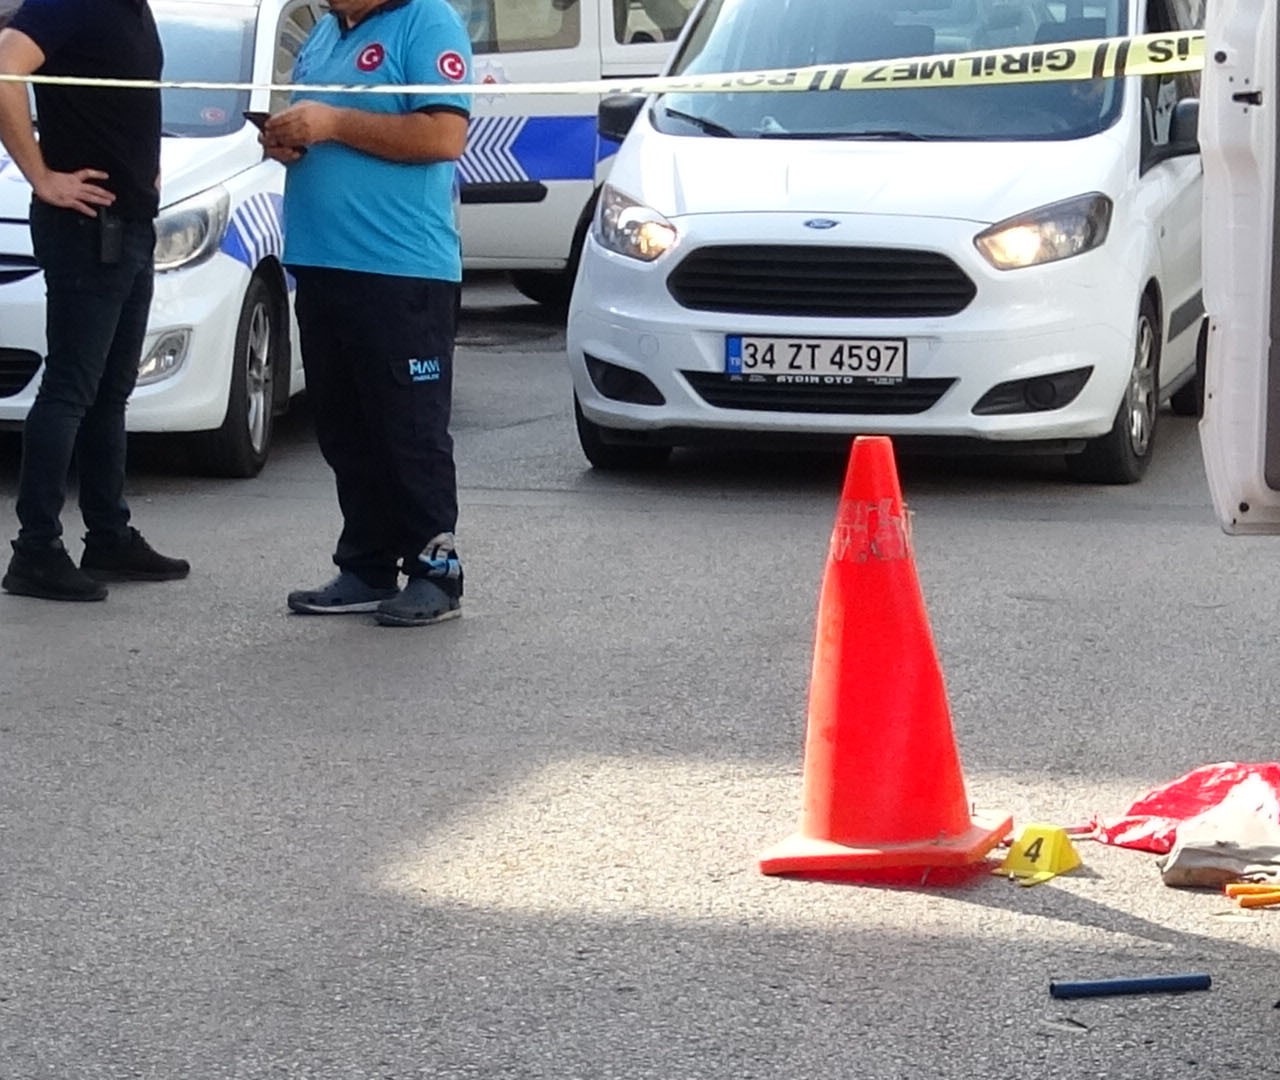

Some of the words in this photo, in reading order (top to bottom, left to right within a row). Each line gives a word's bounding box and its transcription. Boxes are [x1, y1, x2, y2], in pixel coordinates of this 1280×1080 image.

[1148, 37, 1205, 63] İS
[744, 343, 775, 369] 34
[788, 343, 821, 370] ZT
[830, 344, 900, 372] 4597
[1023, 837, 1044, 863] 4
